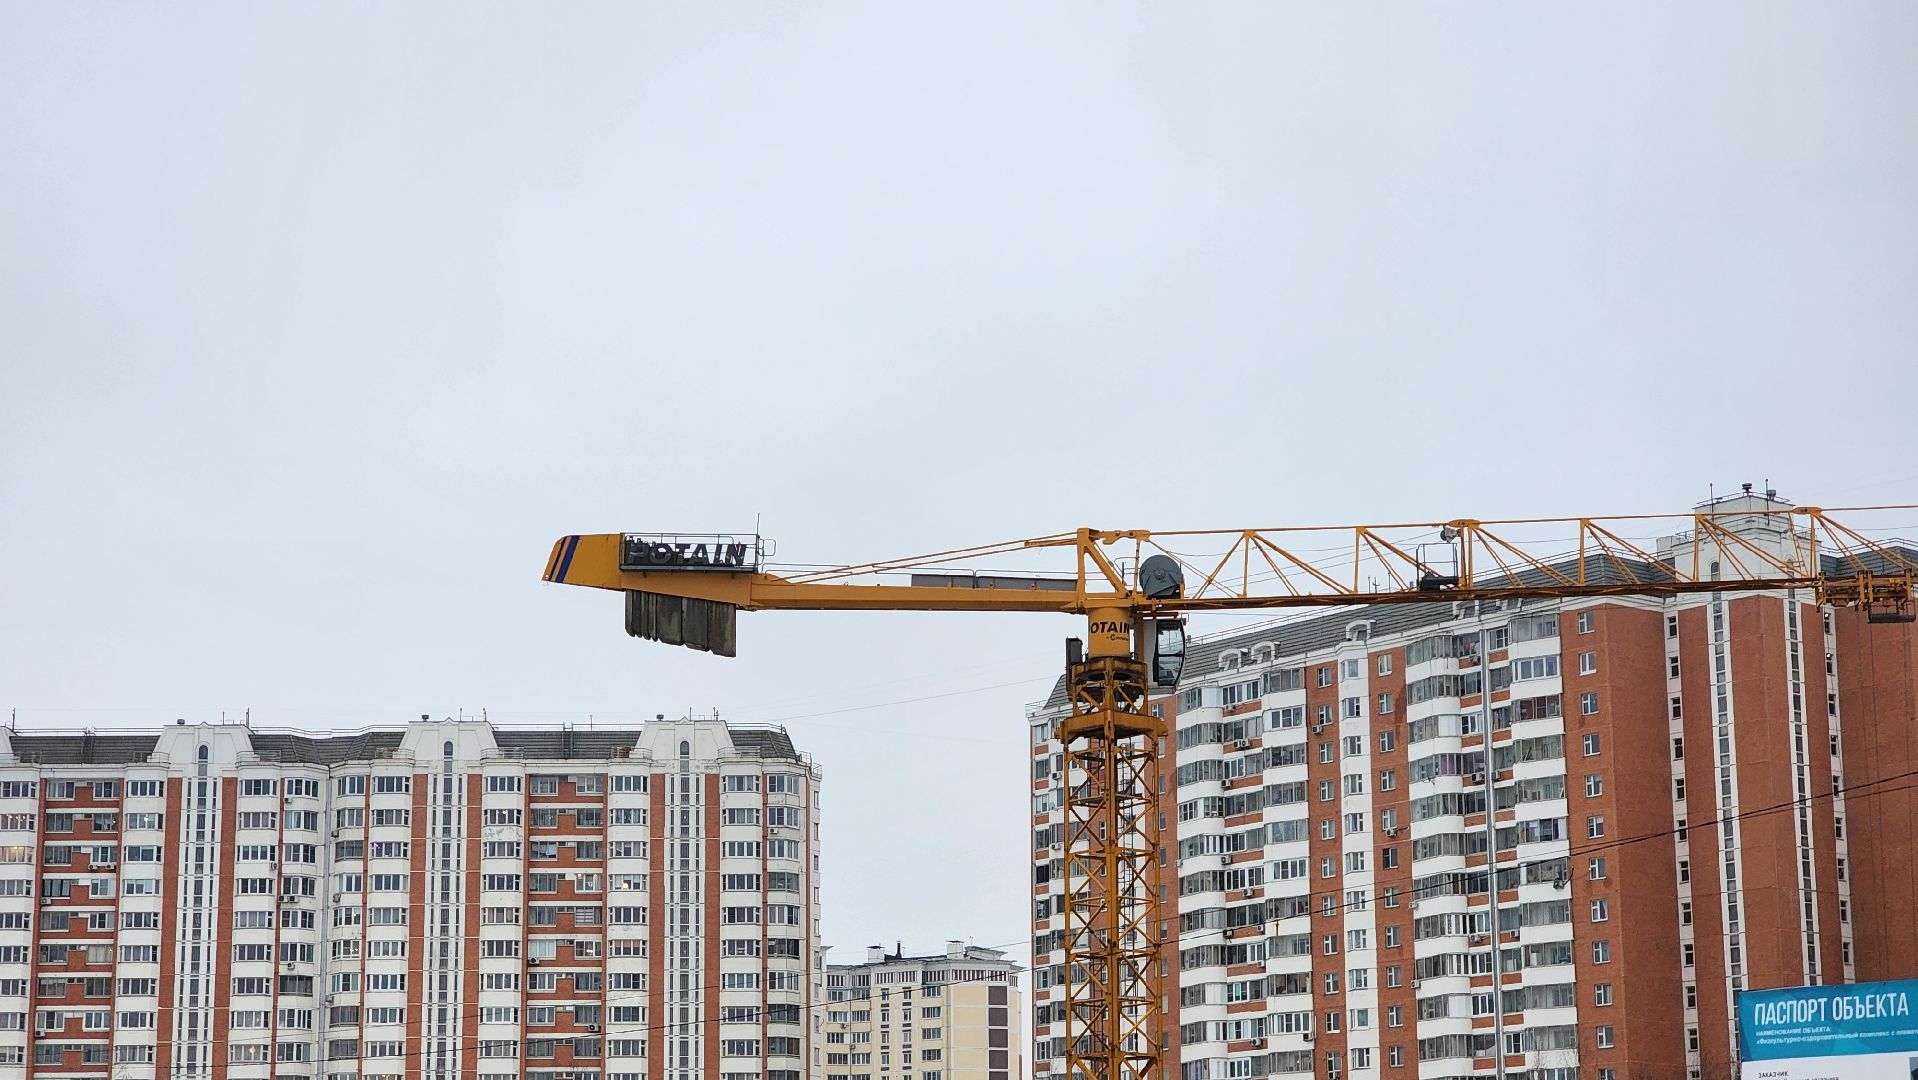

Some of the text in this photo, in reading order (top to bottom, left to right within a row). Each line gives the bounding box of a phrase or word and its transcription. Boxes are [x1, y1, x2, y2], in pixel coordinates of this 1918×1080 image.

[628, 541, 747, 566] POTAIN
[1754, 992, 1910, 1026] ПАСПОРТ ОБЪЕКТА
